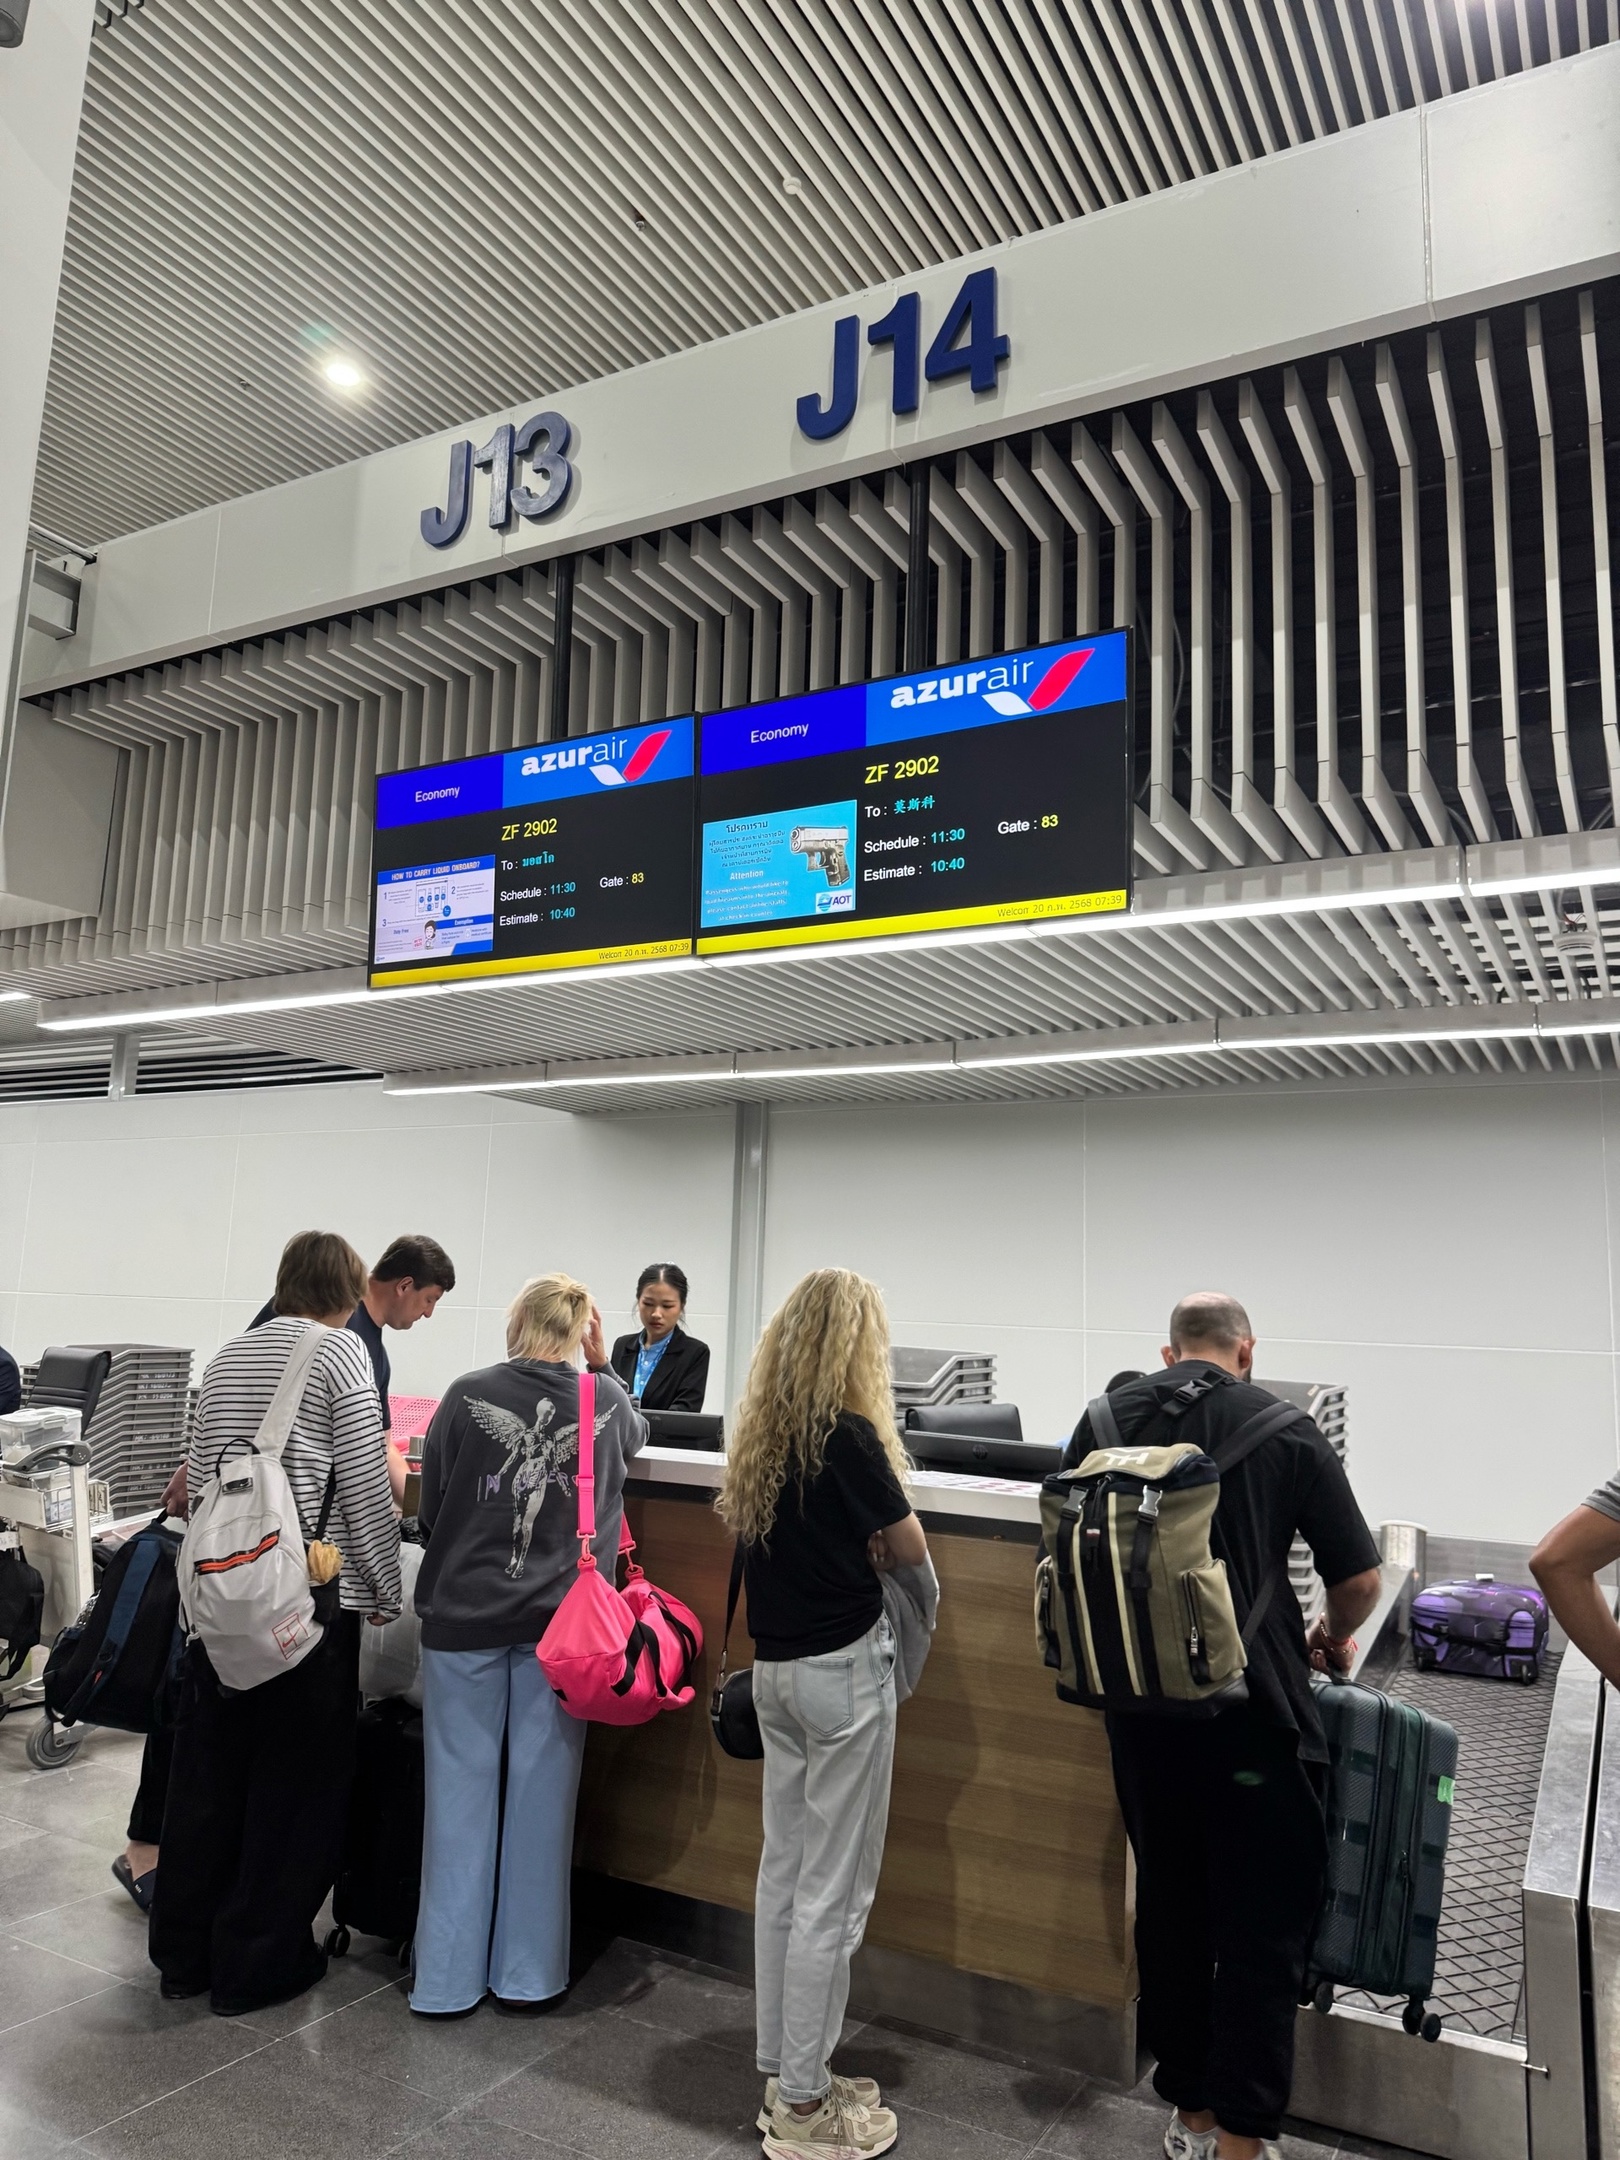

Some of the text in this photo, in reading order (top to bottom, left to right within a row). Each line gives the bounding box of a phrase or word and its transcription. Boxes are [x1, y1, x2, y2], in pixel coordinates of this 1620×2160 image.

[796, 266, 1011, 441] J14
[420, 411, 573, 548] J13
[751, 723, 809, 743] Economy
[864, 755, 939, 784] ZF 2902
[415, 786, 460, 803] Economy
[865, 806, 881, 818] To
[893, 794, 936, 815] 莫斯科
[501, 818, 557, 841] ZF 2902
[997, 819, 1030, 834] Gate
[1041, 814, 1059, 829] 83
[864, 835, 920, 854] Schedule
[931, 828, 965, 844] 11:30
[391, 873, 404, 881] HOW
[406, 871, 413, 879] TO
[414, 868, 431, 876] CARRY
[433, 865, 450, 875] LIQUID
[501, 860, 513, 870] To
[730, 869, 764, 880] Attention
[864, 864, 916, 882] Estimate
[931, 857, 965, 873] 10:40
[600, 876, 623, 888] Gate
[631, 872, 645, 884] 83
[500, 887, 542, 902] Schedule
[550, 882, 576, 895] 11:30
[832, 895, 852, 906] AOT
[1033, 904, 1045, 913] 20
[1069, 898, 1092, 910] 2568
[1095, 894, 1122, 907] 07:39
[499, 912, 539, 926] Estimate
[549, 907, 576, 920] 10:40
[624, 948, 633, 957] 20
[651, 945, 668, 955] 2568
[669, 942, 689, 952] 07:39
[1104, 1452, 1149, 1466] TH
[477, 1474, 501, 1502] IN
